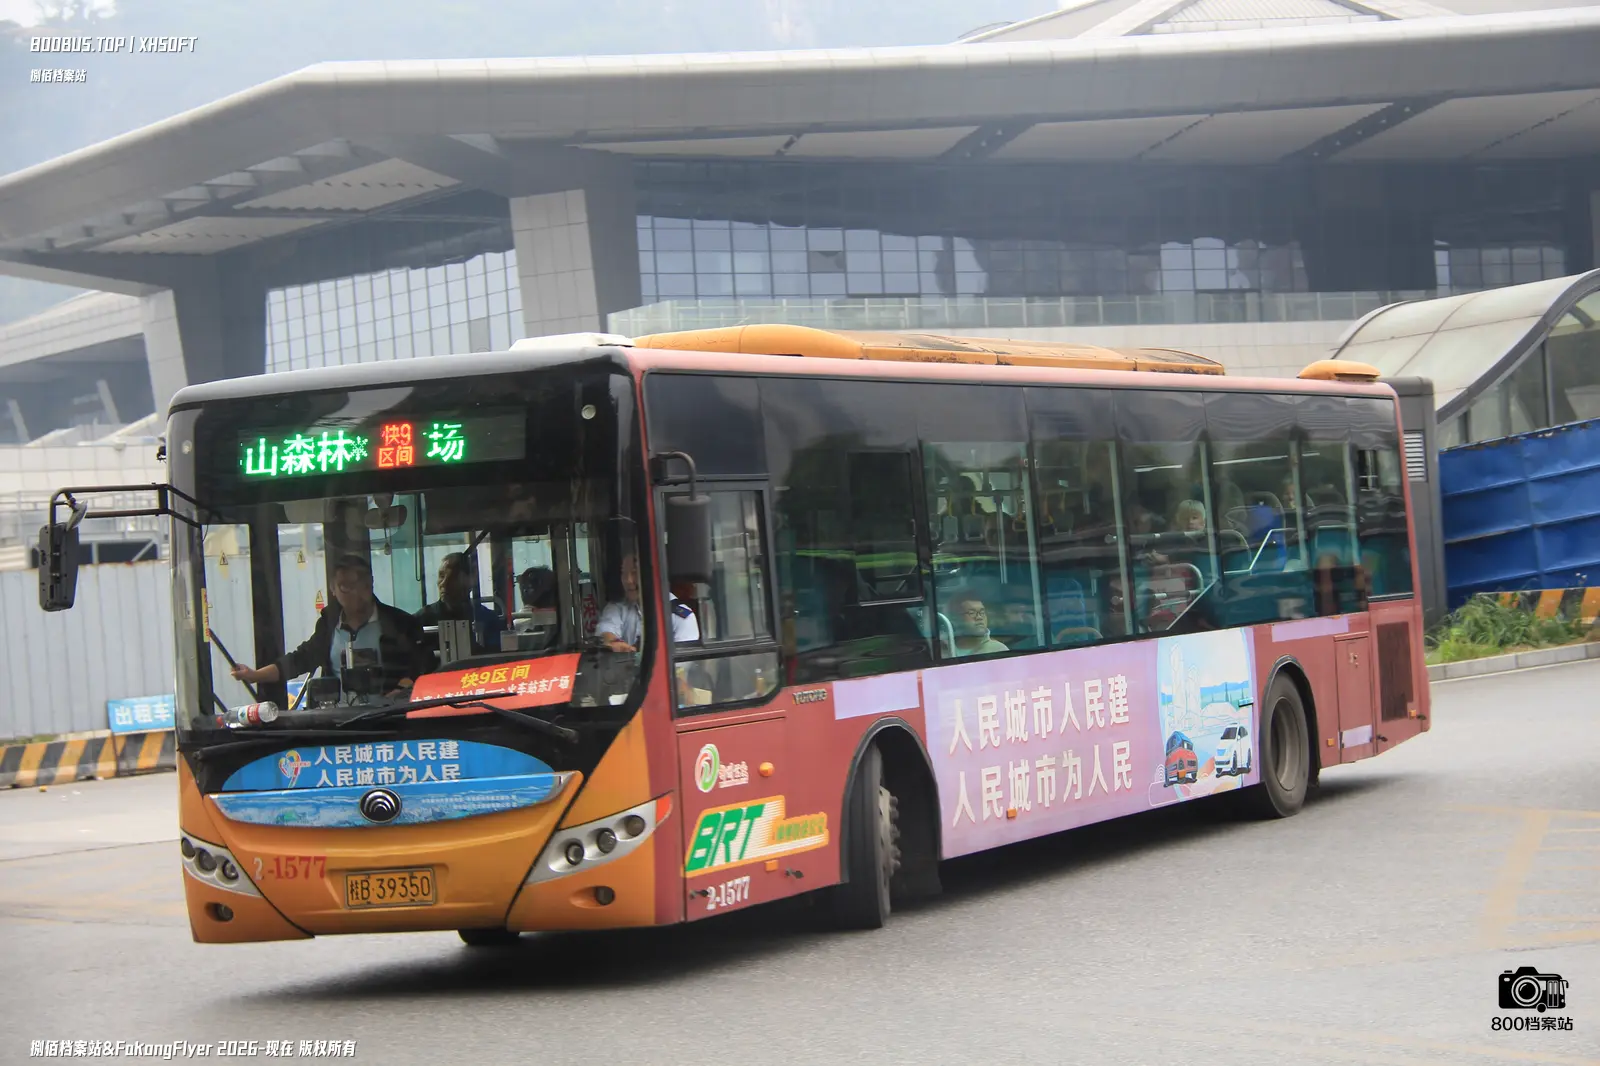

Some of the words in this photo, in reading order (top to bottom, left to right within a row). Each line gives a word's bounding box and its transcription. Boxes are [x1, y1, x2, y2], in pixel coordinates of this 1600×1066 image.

[382, 424, 412, 446] 快9
[423, 423, 465, 462] 场
[378, 446, 413, 468] 区间
[460, 664, 531, 688] 快9区间
[114, 702, 172, 726] 出租车
[949, 674, 1130, 755] 人民城市人民建
[314, 741, 460, 766] 人民城市人民建
[316, 763, 461, 788] 人民城市为人民
[952, 740, 1133, 828] 人民城市为人民
[685, 803, 766, 872] BRT
[252, 855, 328, 881] 2-1577
[706, 875, 750, 911] 2-1577
